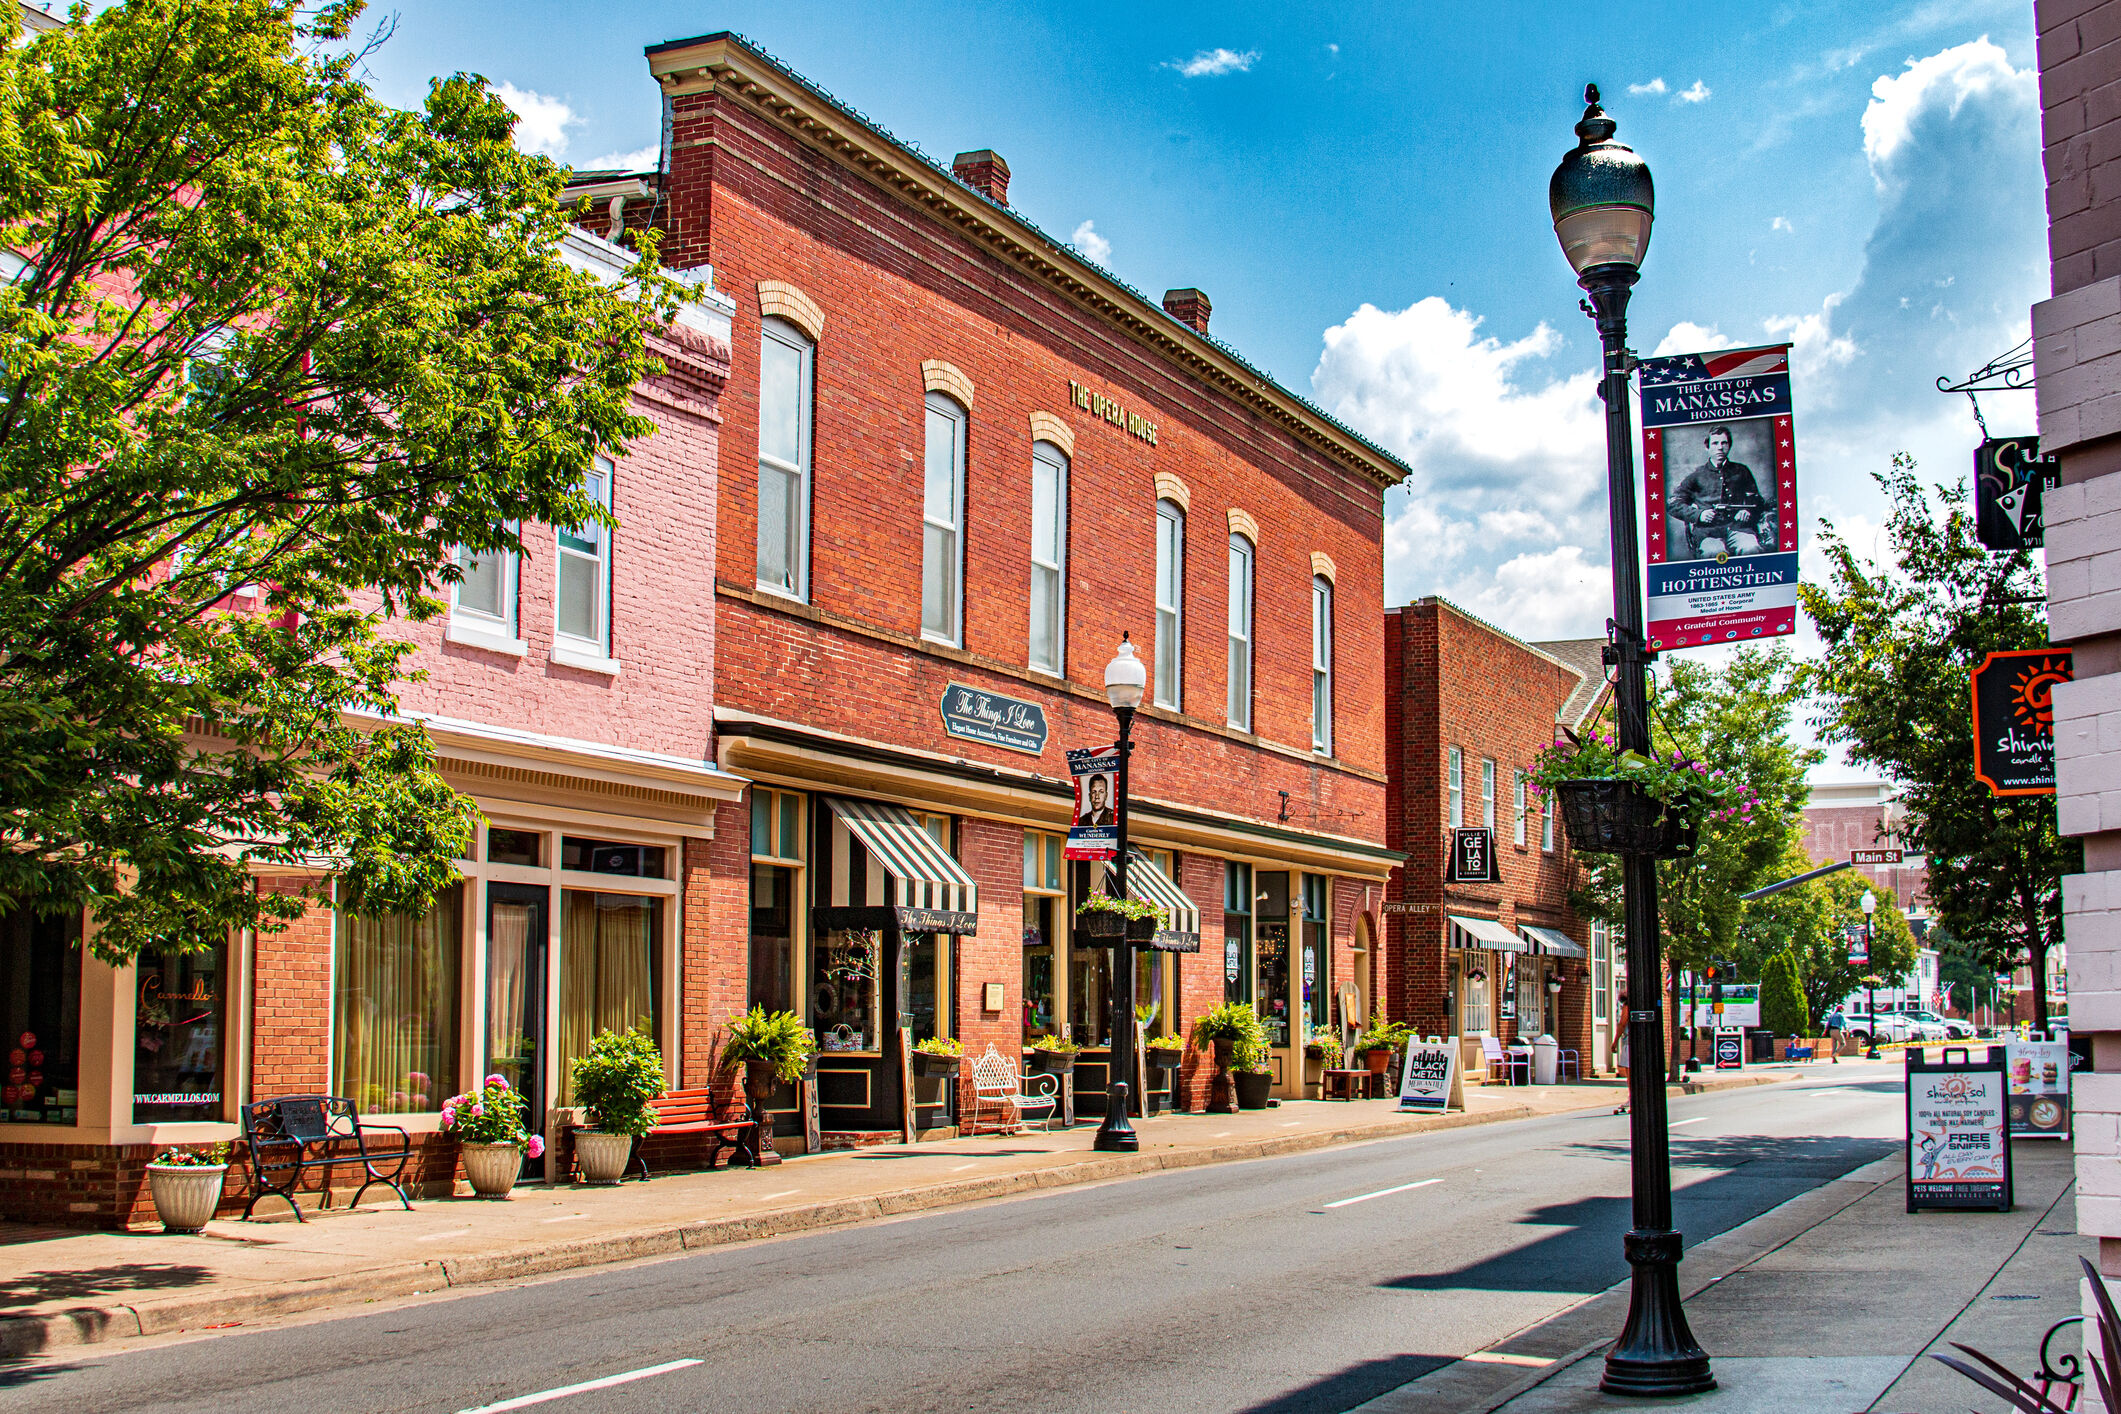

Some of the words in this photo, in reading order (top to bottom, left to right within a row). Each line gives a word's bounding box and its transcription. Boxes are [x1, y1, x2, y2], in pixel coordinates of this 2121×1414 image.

[1677, 384, 1702, 395] THE
[1704, 380, 1733, 392] CITY
[1736, 379, 1753, 388] OF
[1655, 386, 1776, 413] MANASSAS
[1070, 379, 1090, 410] THE
[1092, 392, 1126, 429] OPERA
[1127, 411, 1158, 446] HOUSE
[1690, 406, 1742, 420] HONORS
[1689, 565, 1743, 578] Solomon
[1746, 563, 1755, 573] J.
[1661, 570, 1784, 593] HOTTENSTEIN
[1712, 593, 1737, 601] STATES
[1737, 591, 1756, 599] ARMY
[1728, 597, 1754, 605] Corporal
[1700, 606, 1718, 614] Medal
[1725, 604, 1743, 612] Honor
[1683, 620, 1717, 631] Grateful
[1718, 614, 1767, 626] Community
[956, 690, 973, 715] The
[973, 694, 1002, 730] Things
[1013, 705, 1035, 730] Love
[2011, 753, 2043, 764] candle
[1074, 760, 1117, 771] MANASSAS
[2003, 775, 2056, 785] www.shini
[1464, 837, 1482, 848] GE
[1467, 848, 1482, 860] LA
[1855, 852, 1883, 862] Main
[1885, 851, 1898, 862] St
[1466, 859, 1481, 871] TO
[1384, 904, 1406, 913] OPERA
[1409, 904, 1430, 913] ALLEY
[901, 909, 917, 924] The
[919, 911, 946, 928] Things
[956, 914, 977, 929] Love
[1413, 1061, 1445, 1070] BLACK
[1412, 1070, 1444, 1079] METAL
[1408, 1080, 1444, 1090] MERCANTILE
[1926, 1085, 1967, 1104] shining
[1969, 1084, 1986, 1098] sol
[1973, 1109, 1995, 1117] CANDLES
[1948, 1133, 1990, 1142] FREE
[1948, 1142, 1991, 1150] SNIFFS
[1946, 1156, 1973, 1164] EVERY
[1913, 1184, 1927, 1192] PETS
[1928, 1184, 1953, 1192] WELCOME
